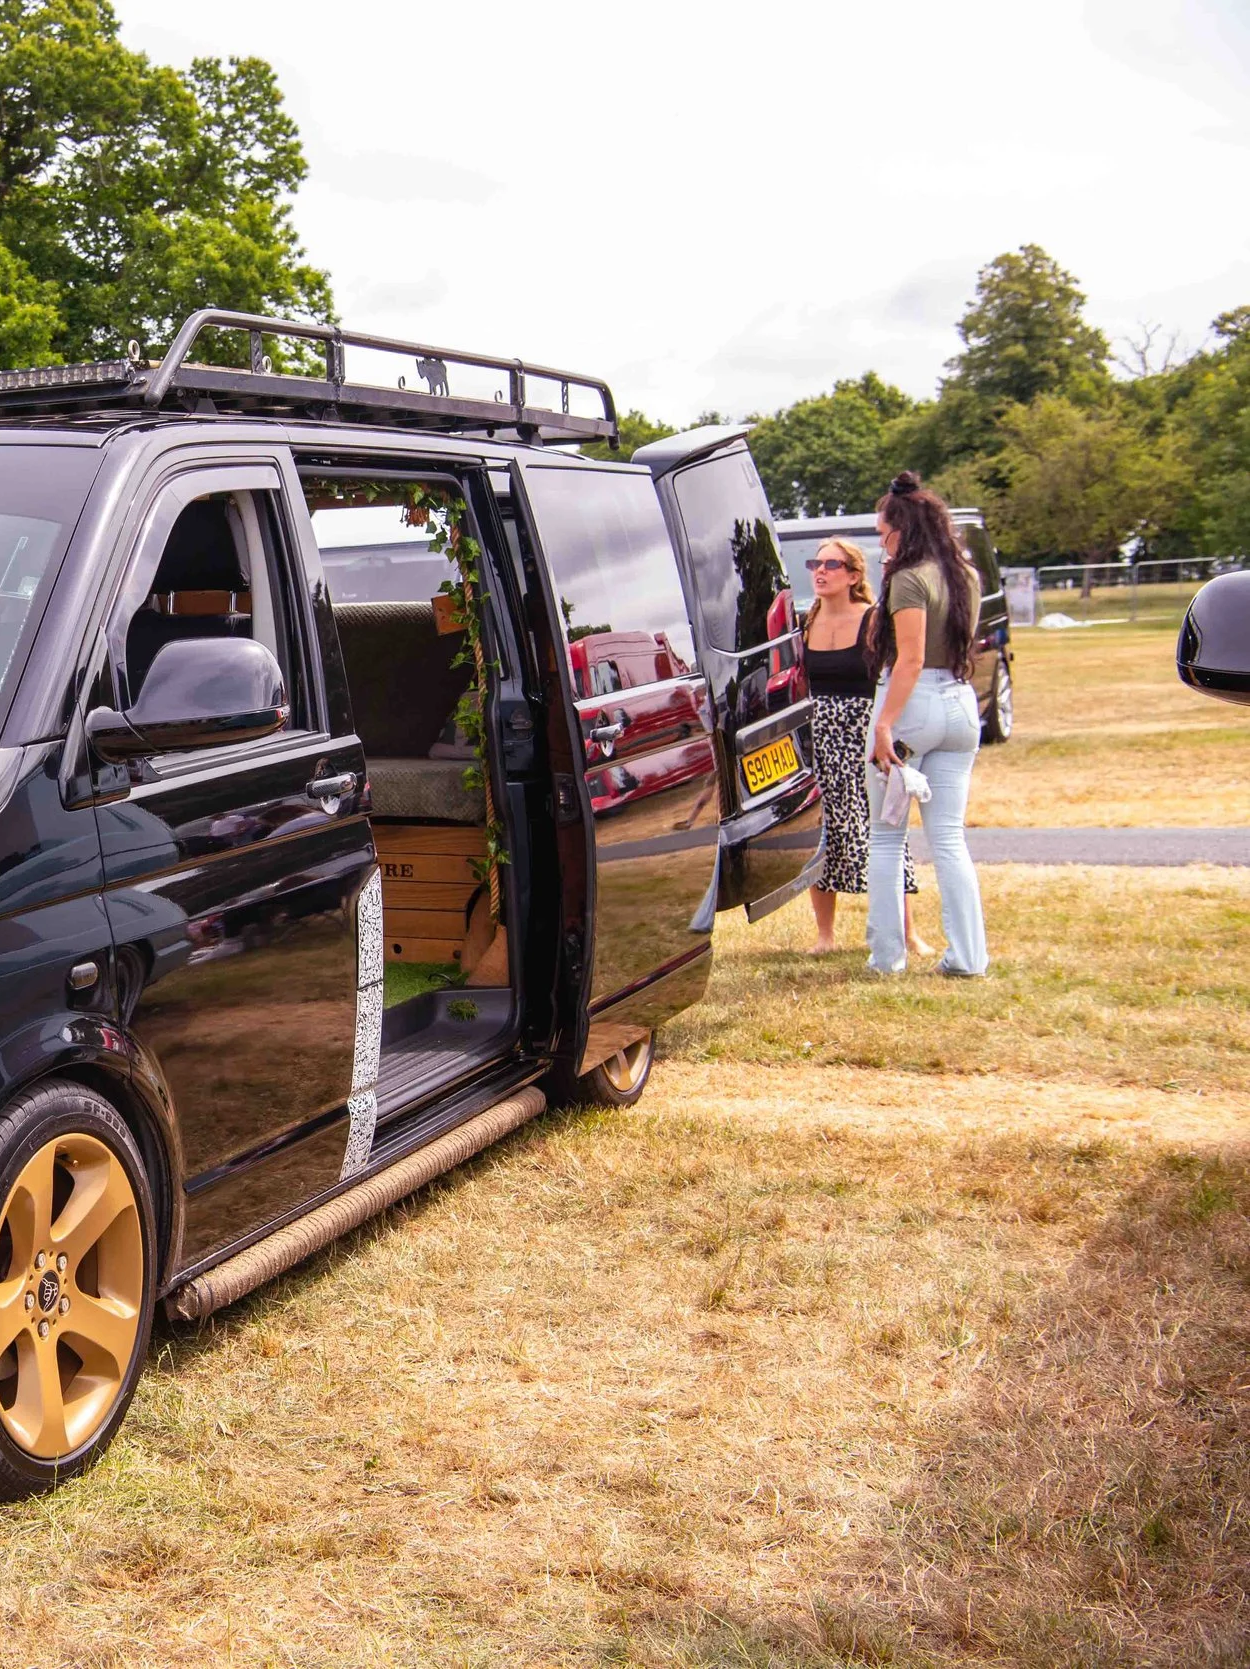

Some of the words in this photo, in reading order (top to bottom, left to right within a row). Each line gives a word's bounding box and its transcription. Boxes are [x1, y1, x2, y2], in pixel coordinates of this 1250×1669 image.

[747, 753, 772, 786] S90
[770, 742, 794, 775] HAD
[379, 863, 414, 878] RE
